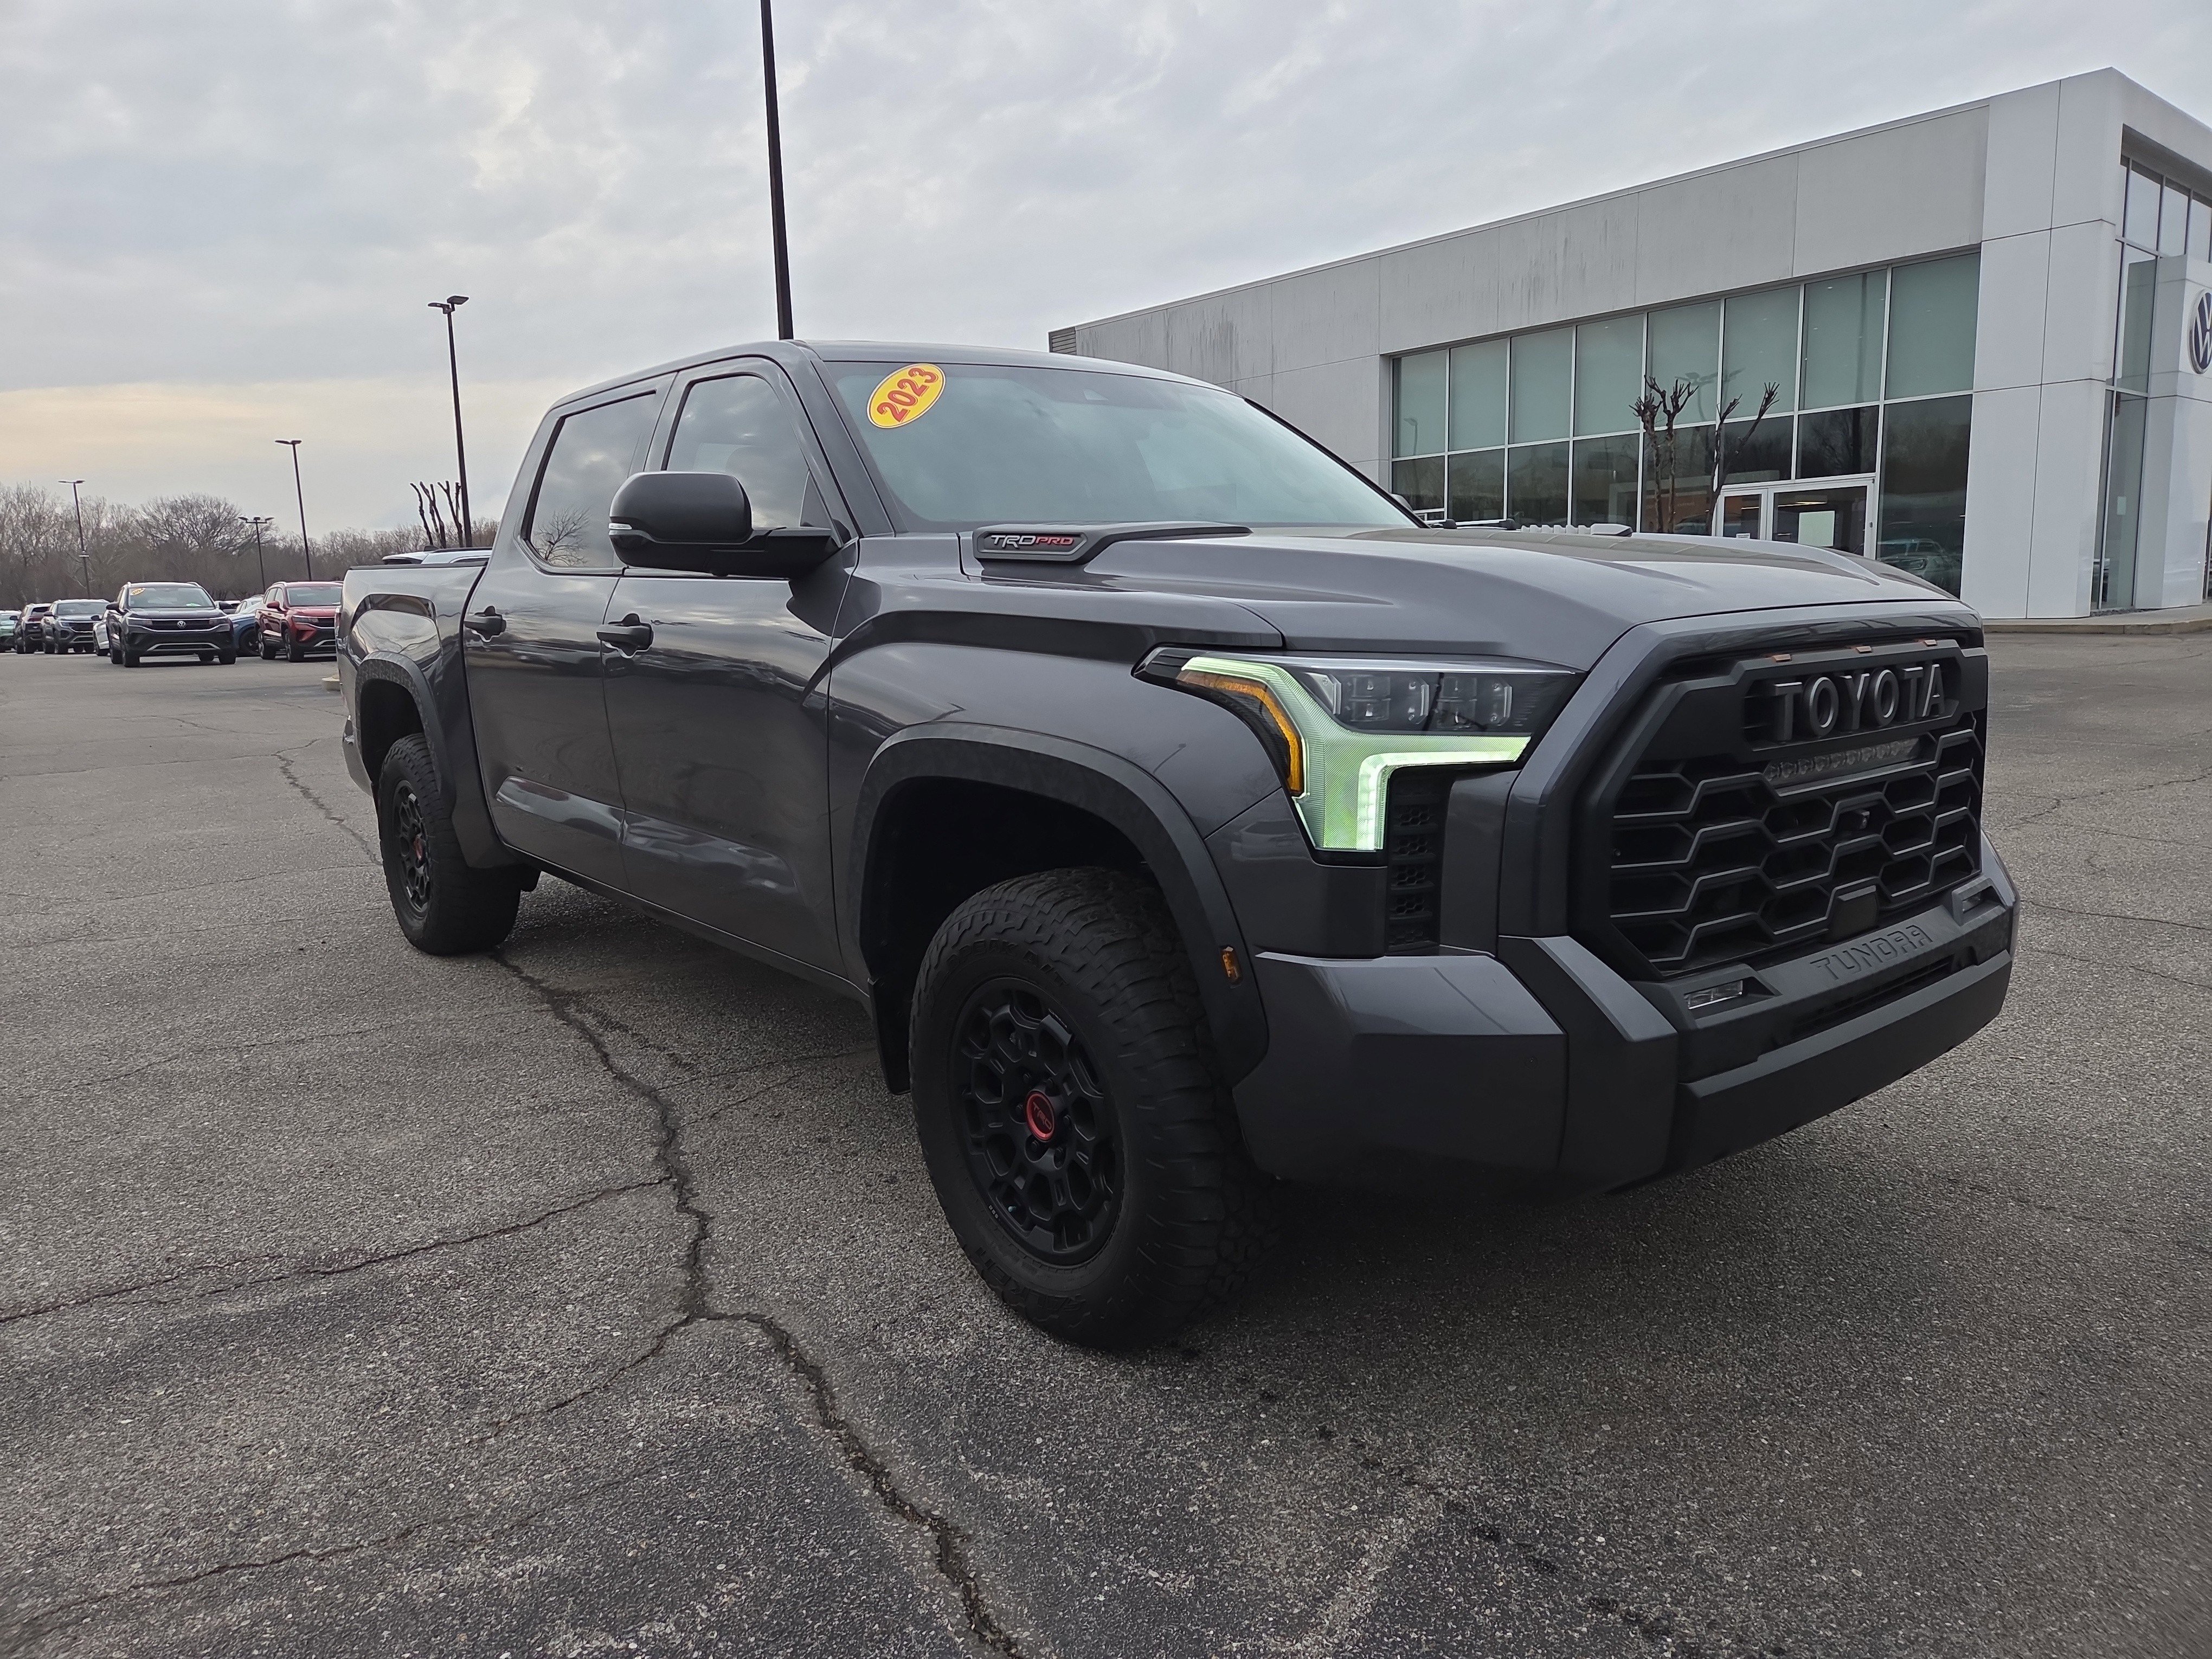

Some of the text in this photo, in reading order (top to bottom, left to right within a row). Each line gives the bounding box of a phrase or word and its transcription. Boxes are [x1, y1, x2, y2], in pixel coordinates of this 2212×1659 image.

[877, 368, 939, 423] 2023
[991, 535, 1036, 549] TRD
[1774, 664, 1946, 742] TOYOTA
[1809, 924, 1933, 980] TUNDRA
